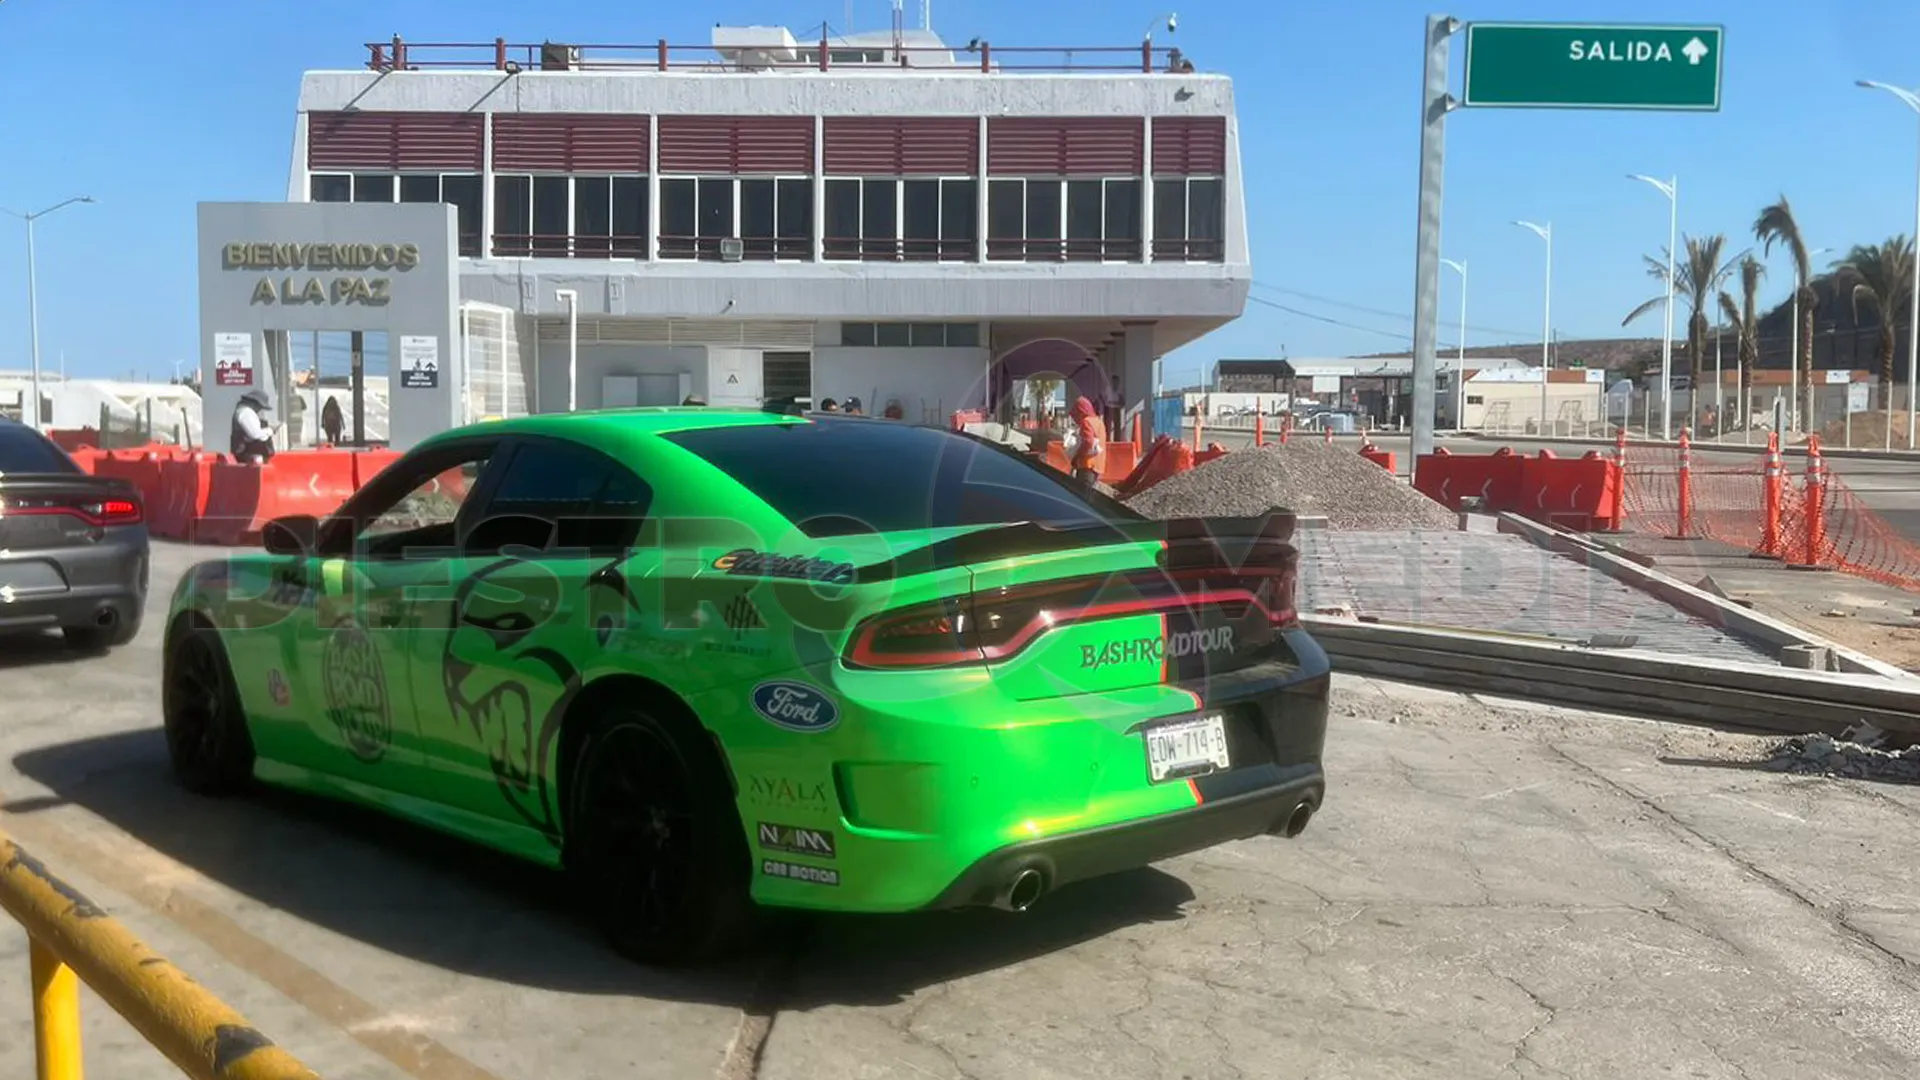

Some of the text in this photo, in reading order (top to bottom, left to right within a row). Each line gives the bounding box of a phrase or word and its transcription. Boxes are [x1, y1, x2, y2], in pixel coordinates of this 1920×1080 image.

[1569, 40, 1672, 61] SALIDA
[223, 242, 419, 269] BIENVENIDOS
[253, 276, 392, 303] A LA PAZ
[766, 686, 821, 724] Ford
[750, 775, 826, 803] AYALA
